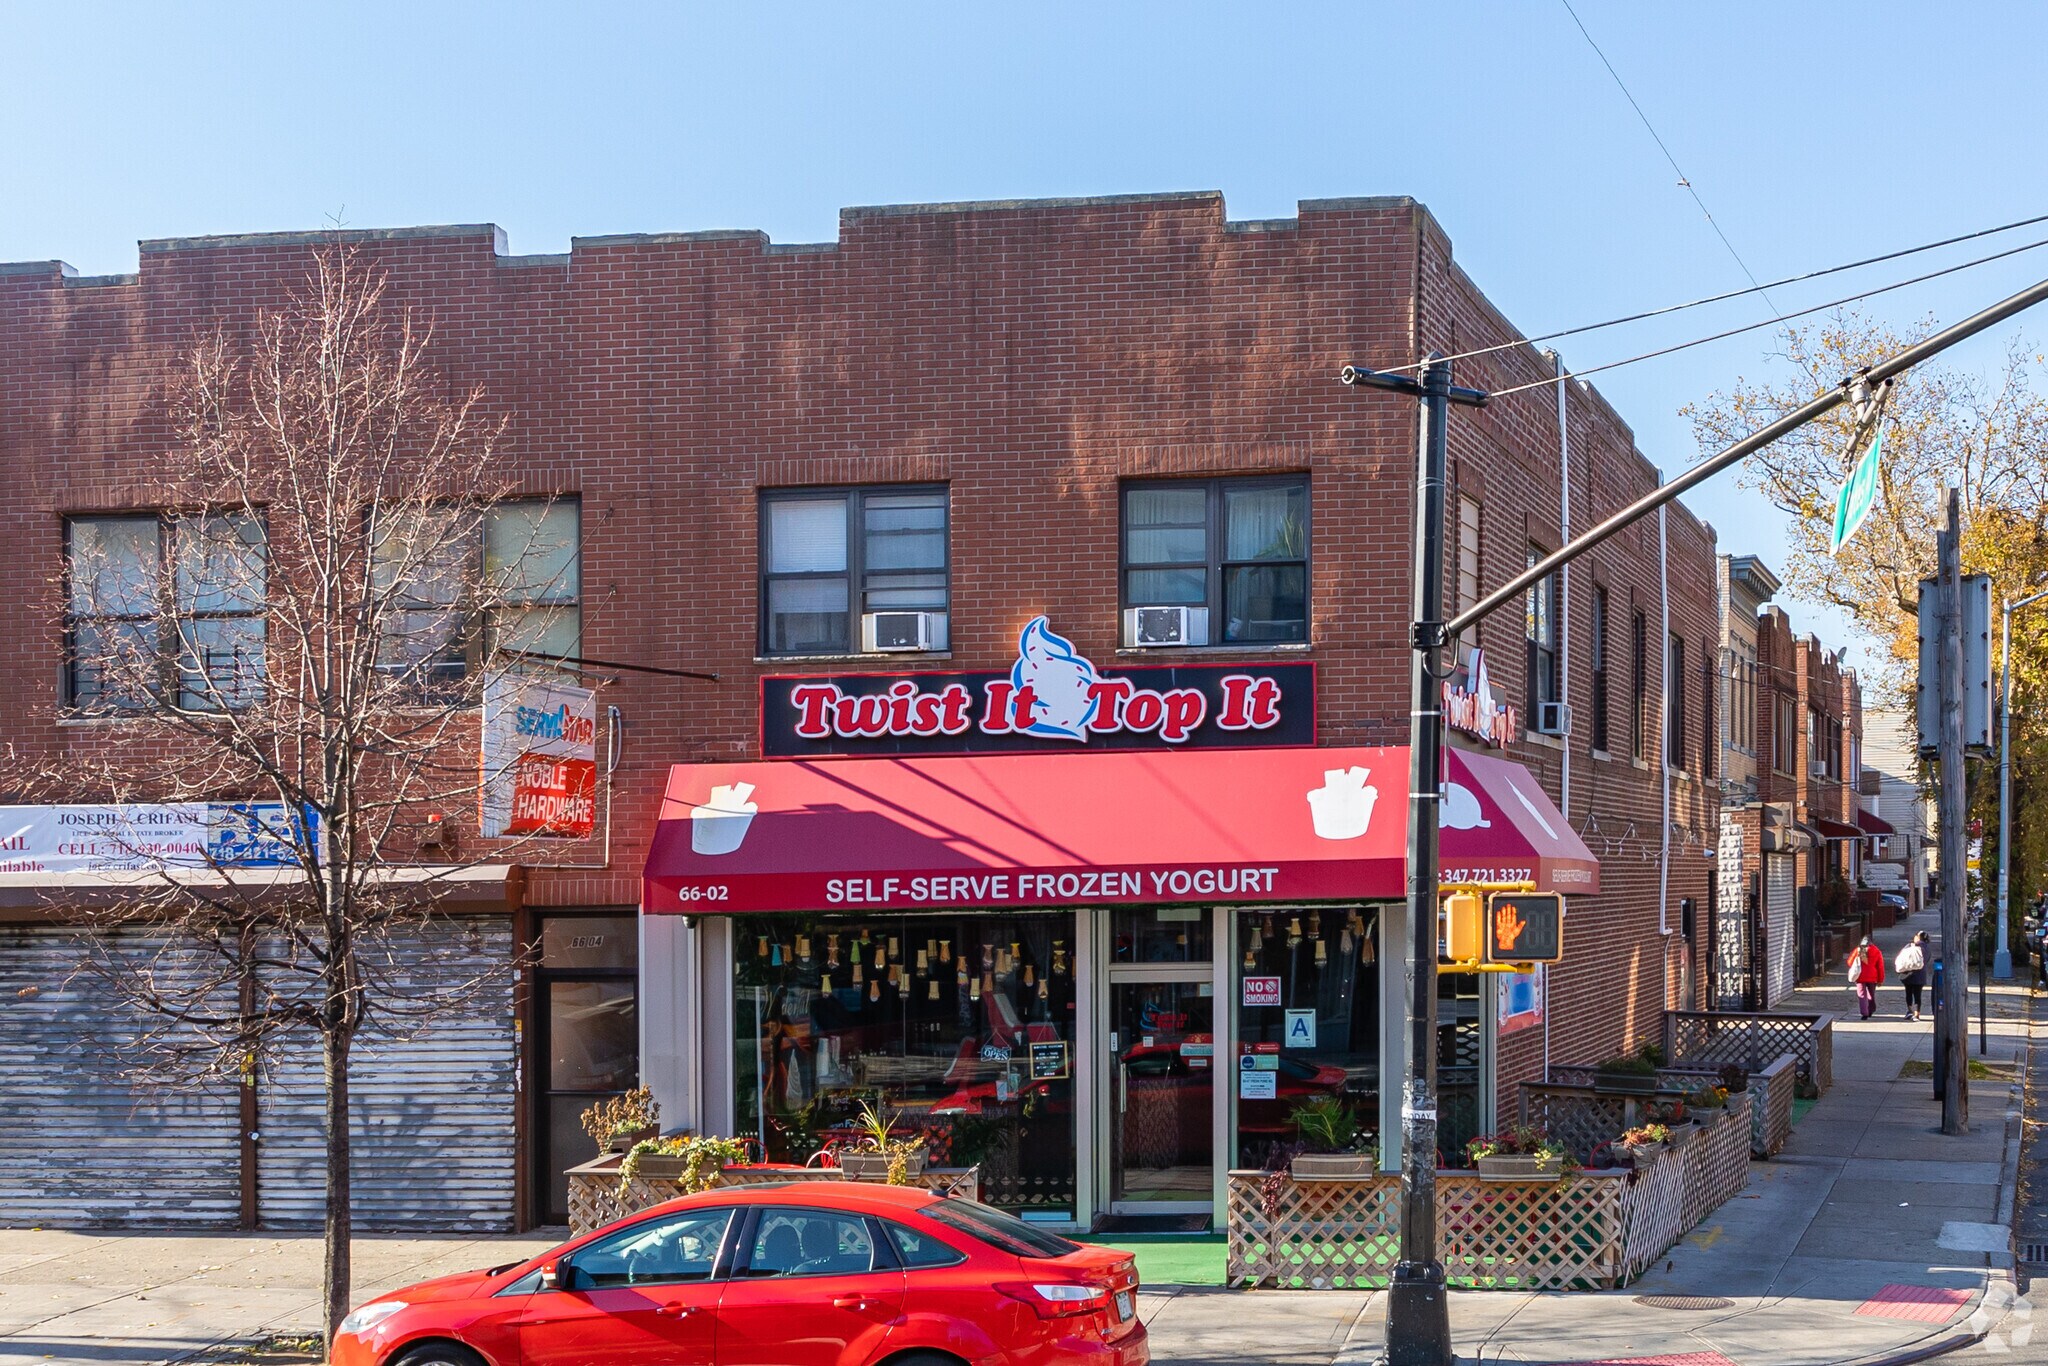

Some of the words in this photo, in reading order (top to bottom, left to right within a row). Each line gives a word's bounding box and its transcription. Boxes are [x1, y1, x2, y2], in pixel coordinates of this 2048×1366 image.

[792, 681, 971, 737] Twist
[980, 681, 1039, 734] It
[1086, 679, 1206, 741] Top
[1217, 676, 1281, 730] It
[520, 764, 568, 790] NOBLE
[518, 794, 592, 822] HARDWARE
[58, 813, 116, 826] JOSEPH
[58, 843, 105, 855] CELL:
[0, 860, 45, 873] ilable
[826, 875, 1010, 902] SELF-SERVE
[1018, 871, 1141, 898] FROZEN
[1150, 868, 1279, 895] YOGURT
[678, 886, 729, 901] 66-02
[1246, 981, 1263, 993] NO
[1245, 994, 1278, 1004] SMOKING
[1291, 1017, 1309, 1037] A
[983, 1048, 1008, 1060] OPEN
